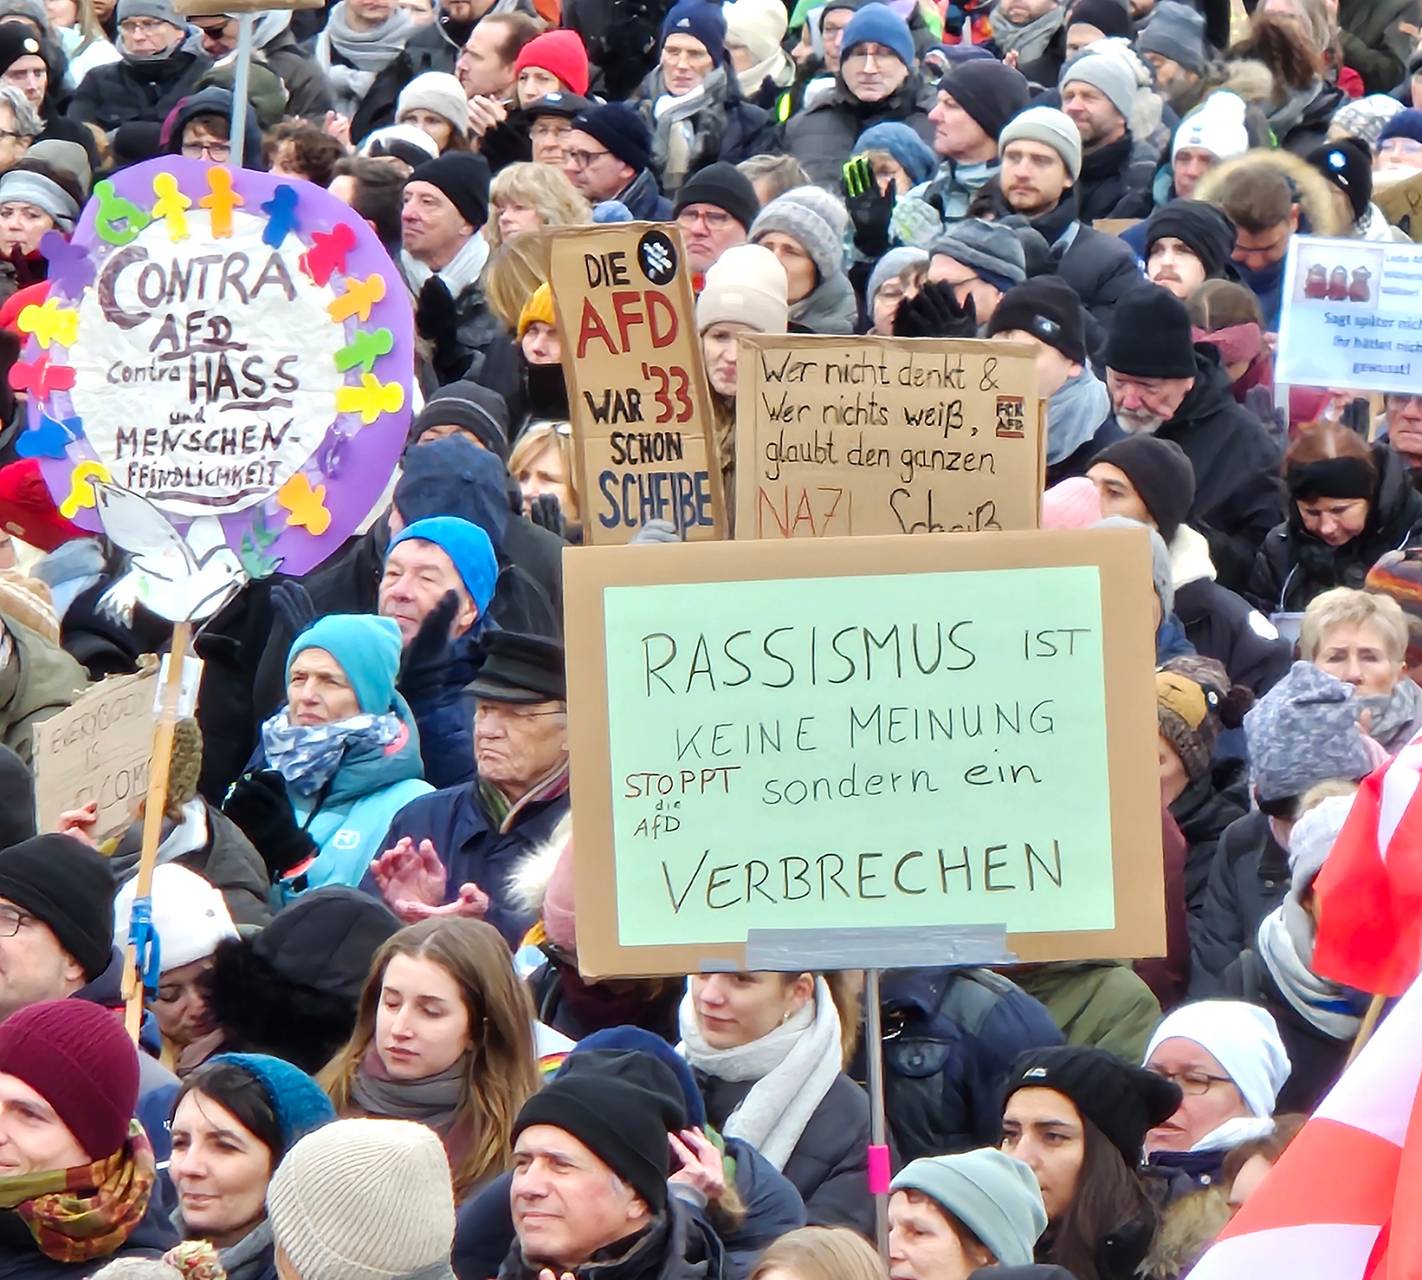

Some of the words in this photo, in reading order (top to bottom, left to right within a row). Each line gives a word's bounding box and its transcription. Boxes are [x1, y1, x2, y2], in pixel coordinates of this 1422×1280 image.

[98, 246, 298, 330] CONTRA
[584, 252, 632, 289] DIE
[150, 310, 233, 352] AFD
[577, 290, 679, 358] AFD
[1324, 311, 1351, 327] Sagt
[189, 353, 300, 405] HASS
[761, 351, 817, 383] Wer
[825, 351, 890, 385] nicht
[898, 351, 965, 390] denkt
[979, 357, 999, 391] &
[584, 388, 645, 425] WAR
[642, 362, 695, 424] '33
[762, 391, 813, 424] Wer
[822, 392, 889, 427] nichts
[169, 406, 206, 424] und
[116, 417, 301, 460] MENSCHEN-
[610, 431, 683, 465] SCHON
[765, 430, 838, 481] glaubt
[847, 431, 890, 468] den
[900, 448, 996, 484] ganzen
[642, 620, 976, 697] RASSISMUS
[1024, 628, 1092, 660] IST
[676, 716, 817, 761] KEINE
[850, 700, 1055, 749] MEINUNG
[625, 766, 741, 799] STOPPT
[761, 763, 938, 805] sondern
[963, 748, 1042, 786] ein
[655, 799, 682, 811] die
[633, 814, 681, 839] AfD
[661, 839, 1064, 914] VERBRECHEN
